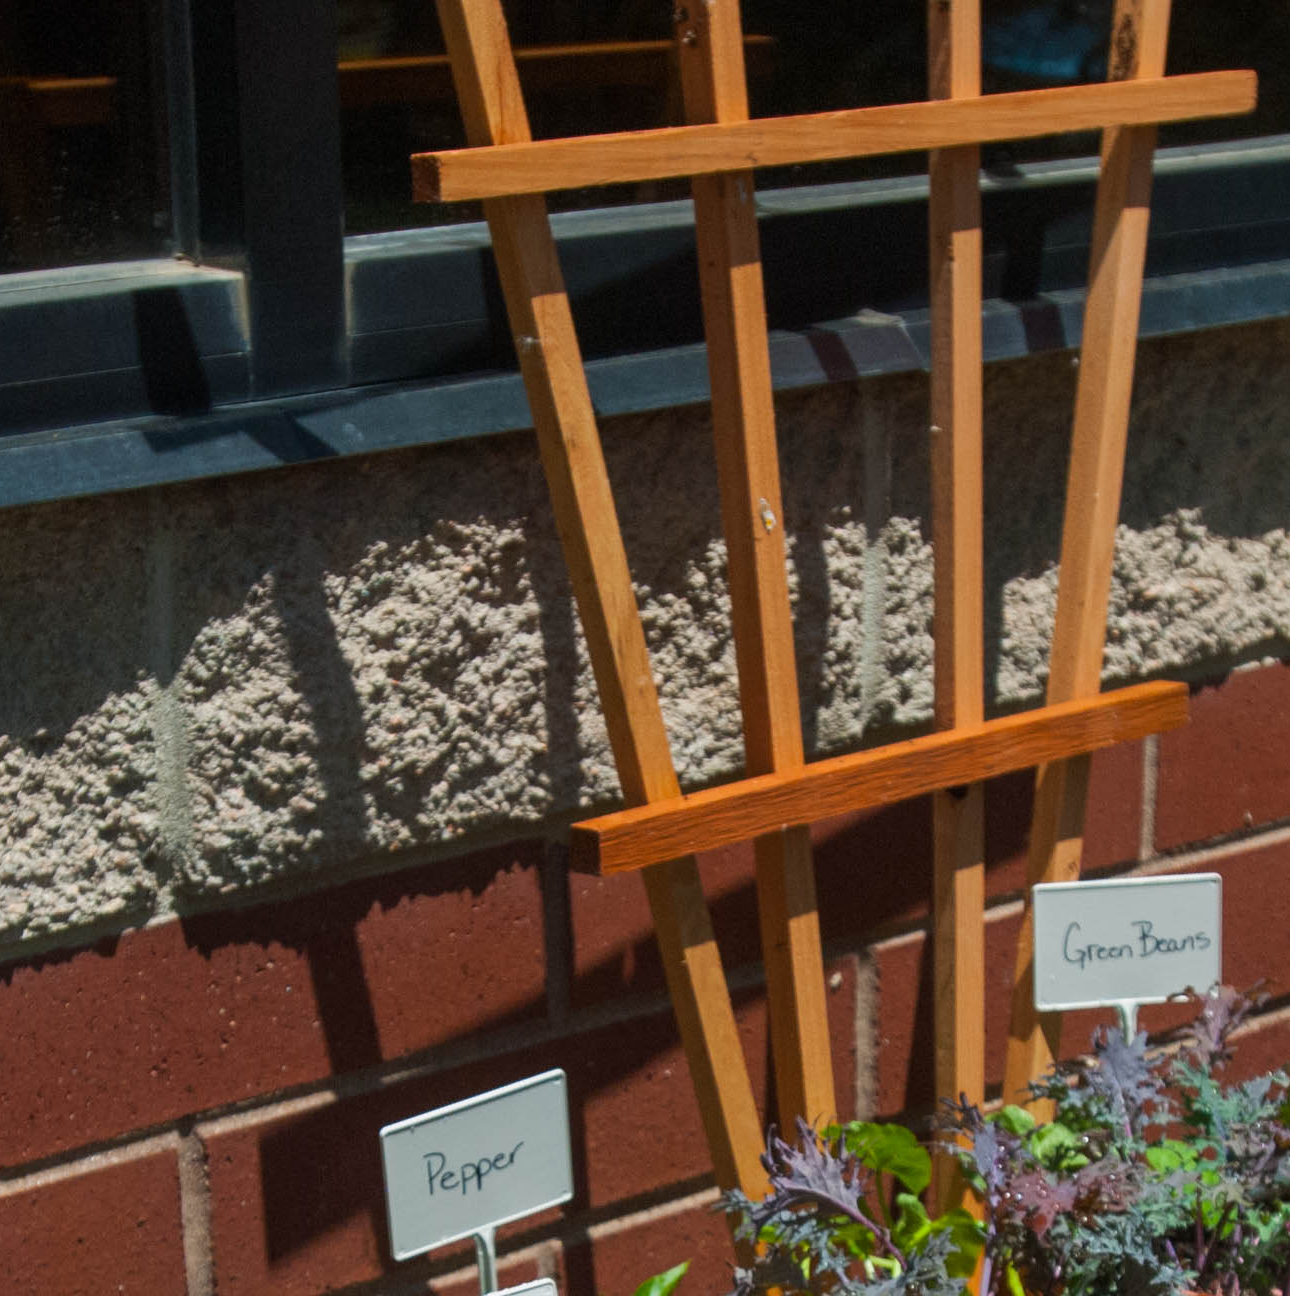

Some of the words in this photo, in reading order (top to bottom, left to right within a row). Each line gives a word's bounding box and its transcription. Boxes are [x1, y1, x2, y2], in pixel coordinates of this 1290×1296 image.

[1063, 921, 1133, 970] Green
[1131, 920, 1211, 958] Beans
[423, 1141, 524, 1195] Pepper
